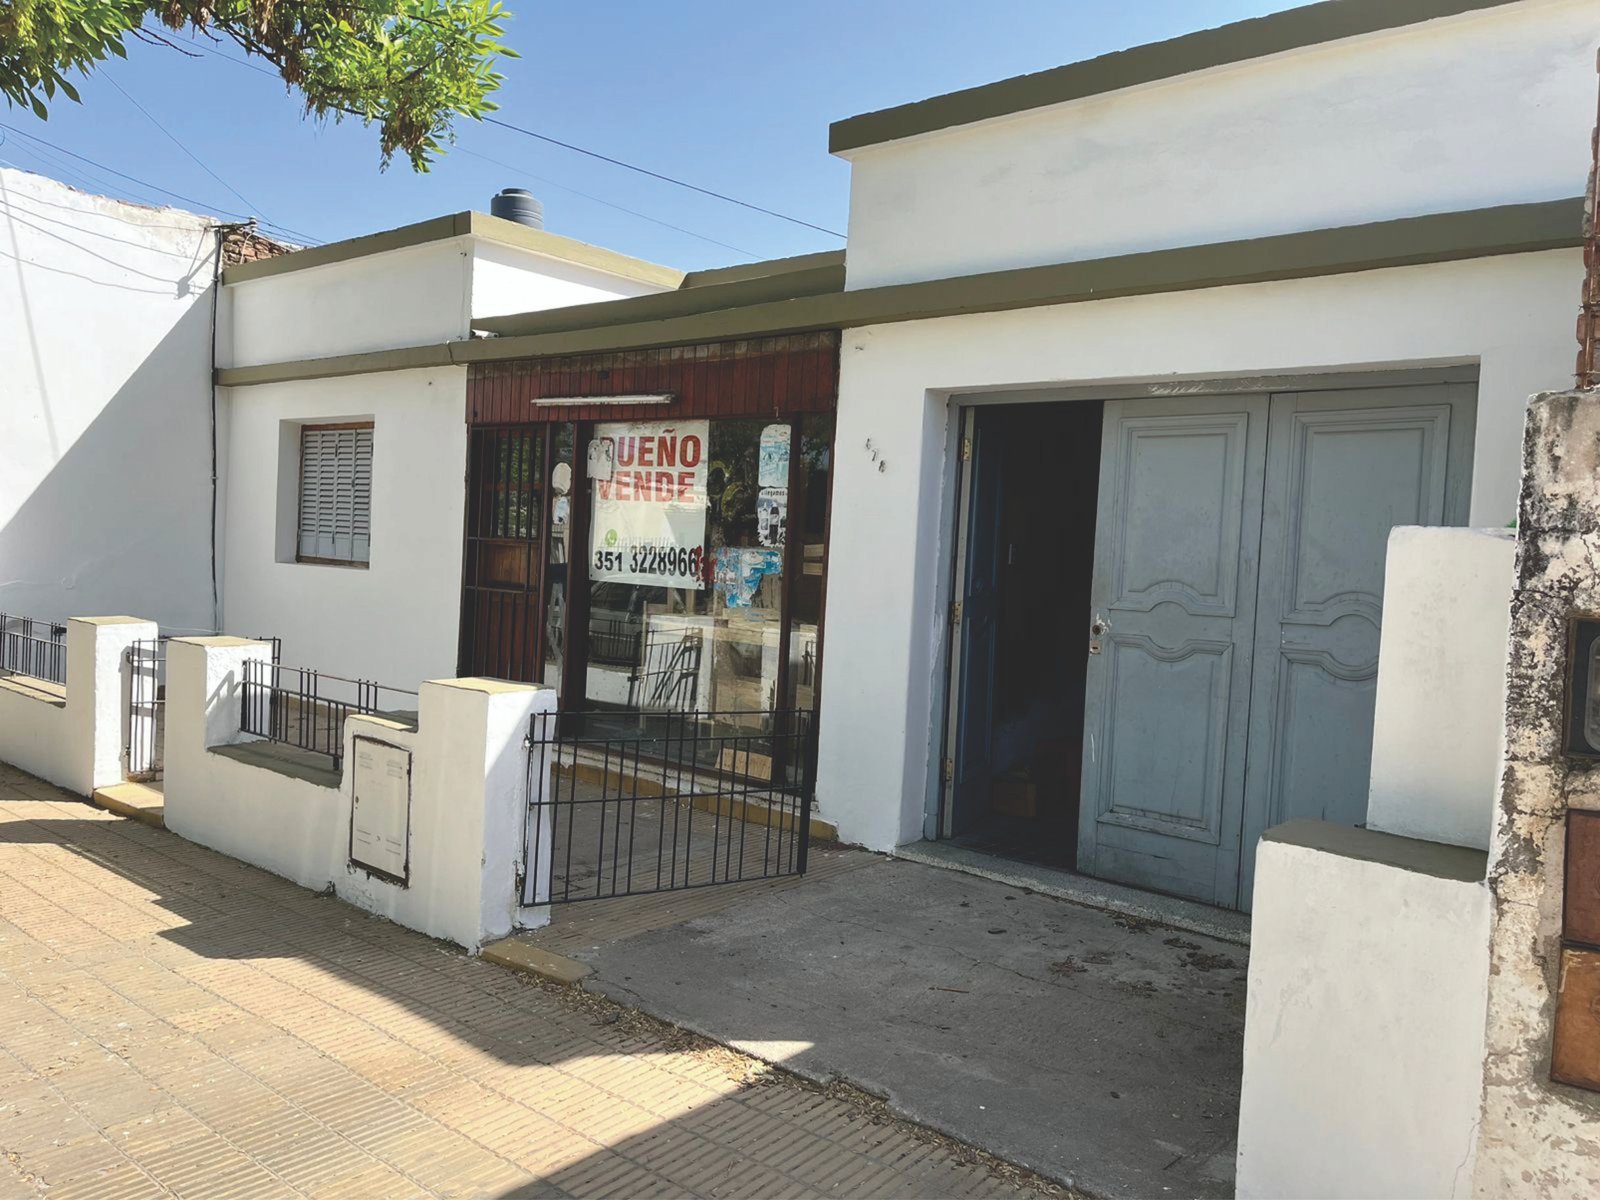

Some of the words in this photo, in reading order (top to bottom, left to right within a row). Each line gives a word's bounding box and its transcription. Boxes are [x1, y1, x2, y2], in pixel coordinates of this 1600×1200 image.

[599, 428, 701, 468] UEÑO
[598, 471, 696, 502] VENDE
[594, 550, 623, 572] 351
[629, 545, 698, 577] 3228966
